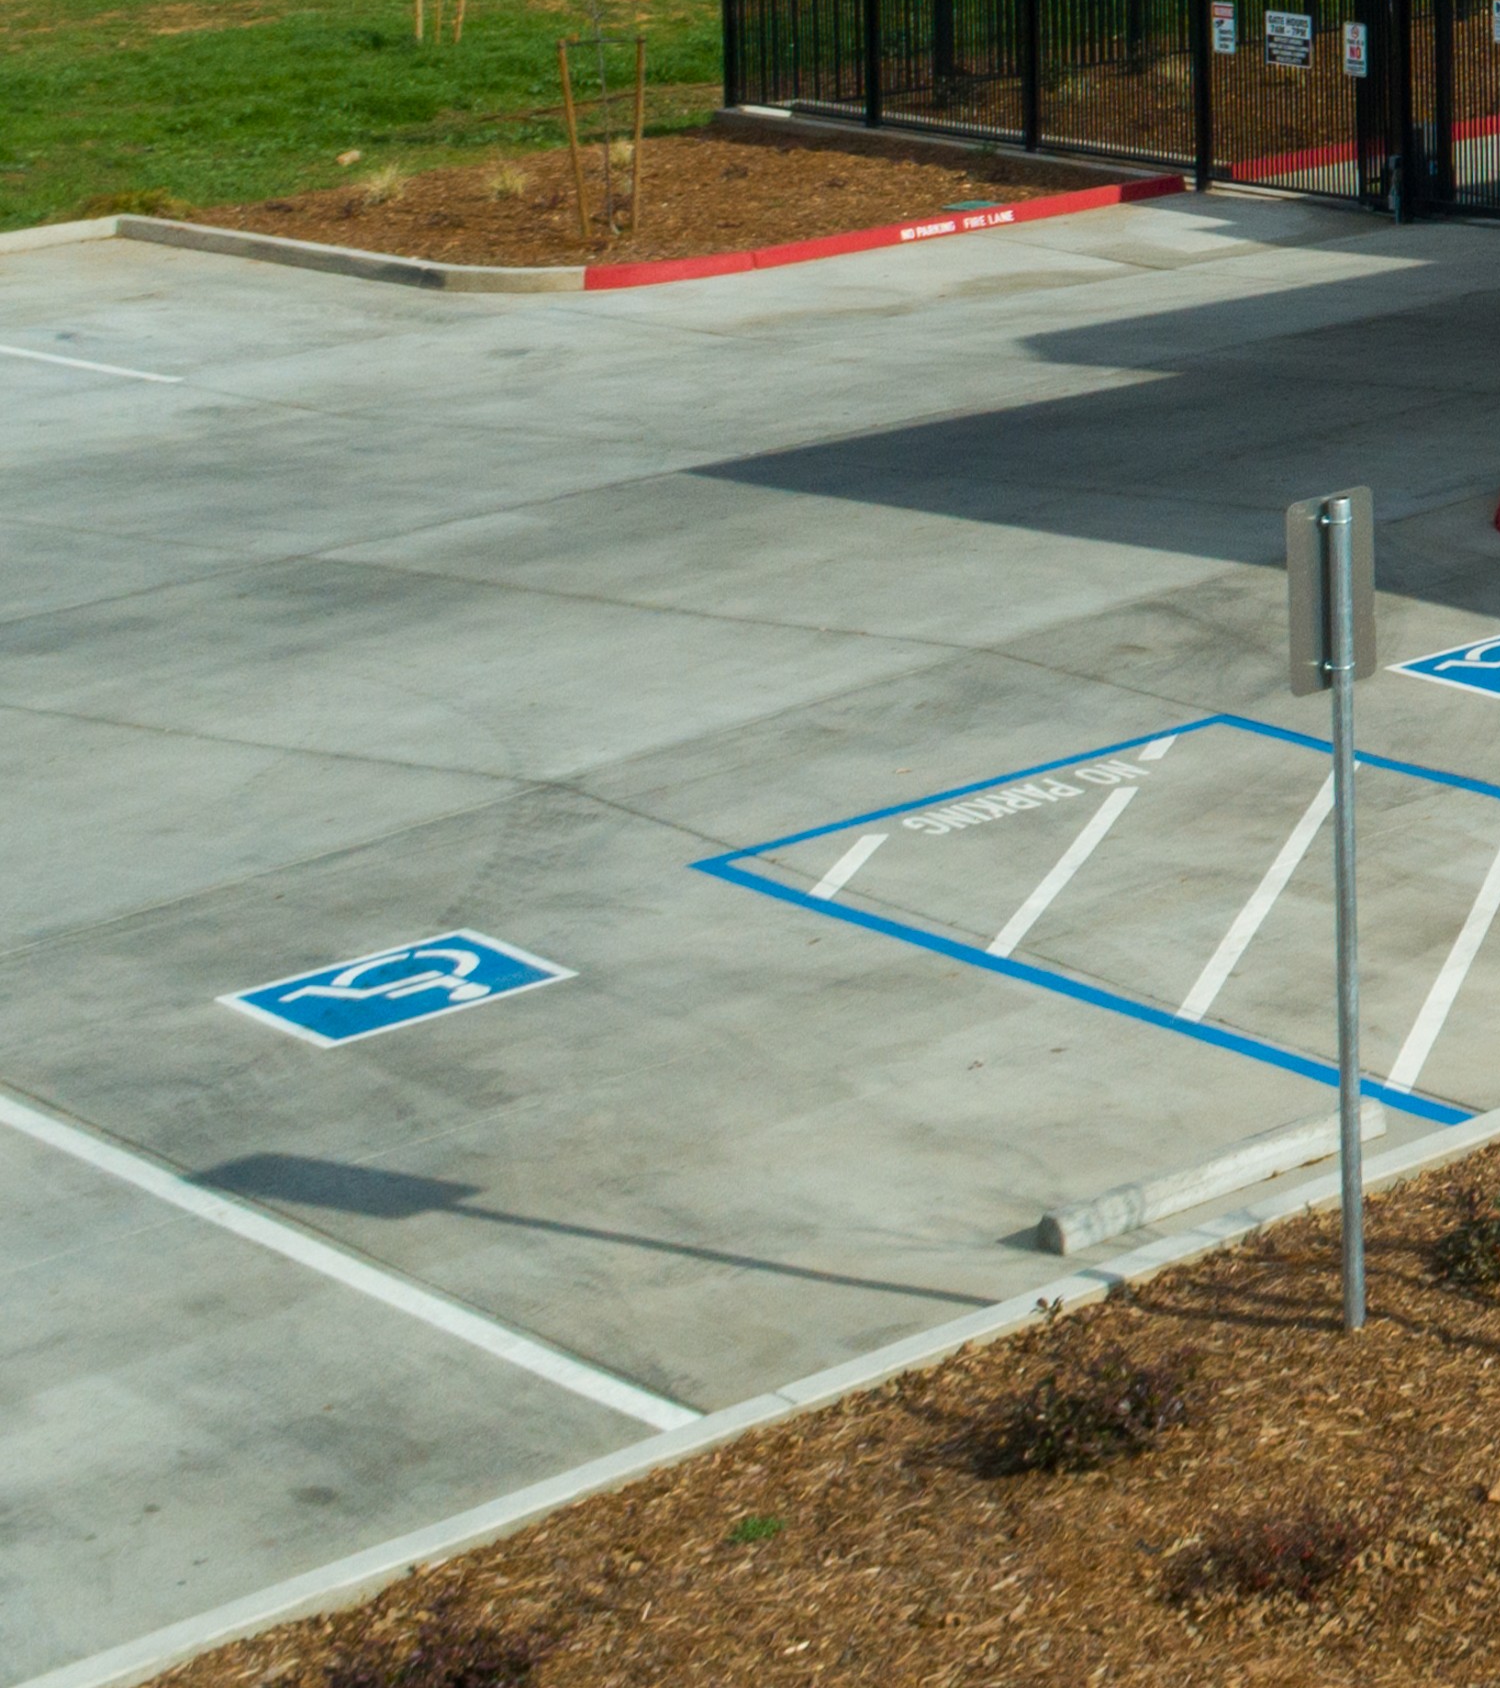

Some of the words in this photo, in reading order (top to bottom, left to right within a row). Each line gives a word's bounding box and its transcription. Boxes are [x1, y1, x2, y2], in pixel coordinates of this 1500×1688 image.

[900, 228, 915, 241] NO
[916, 221, 956, 238] PARKING
[963, 215, 987, 229] FIRE
[988, 210, 1015, 225] LANE
[1074, 759, 1150, 785] NO
[902, 777, 1085, 835] PARKING
